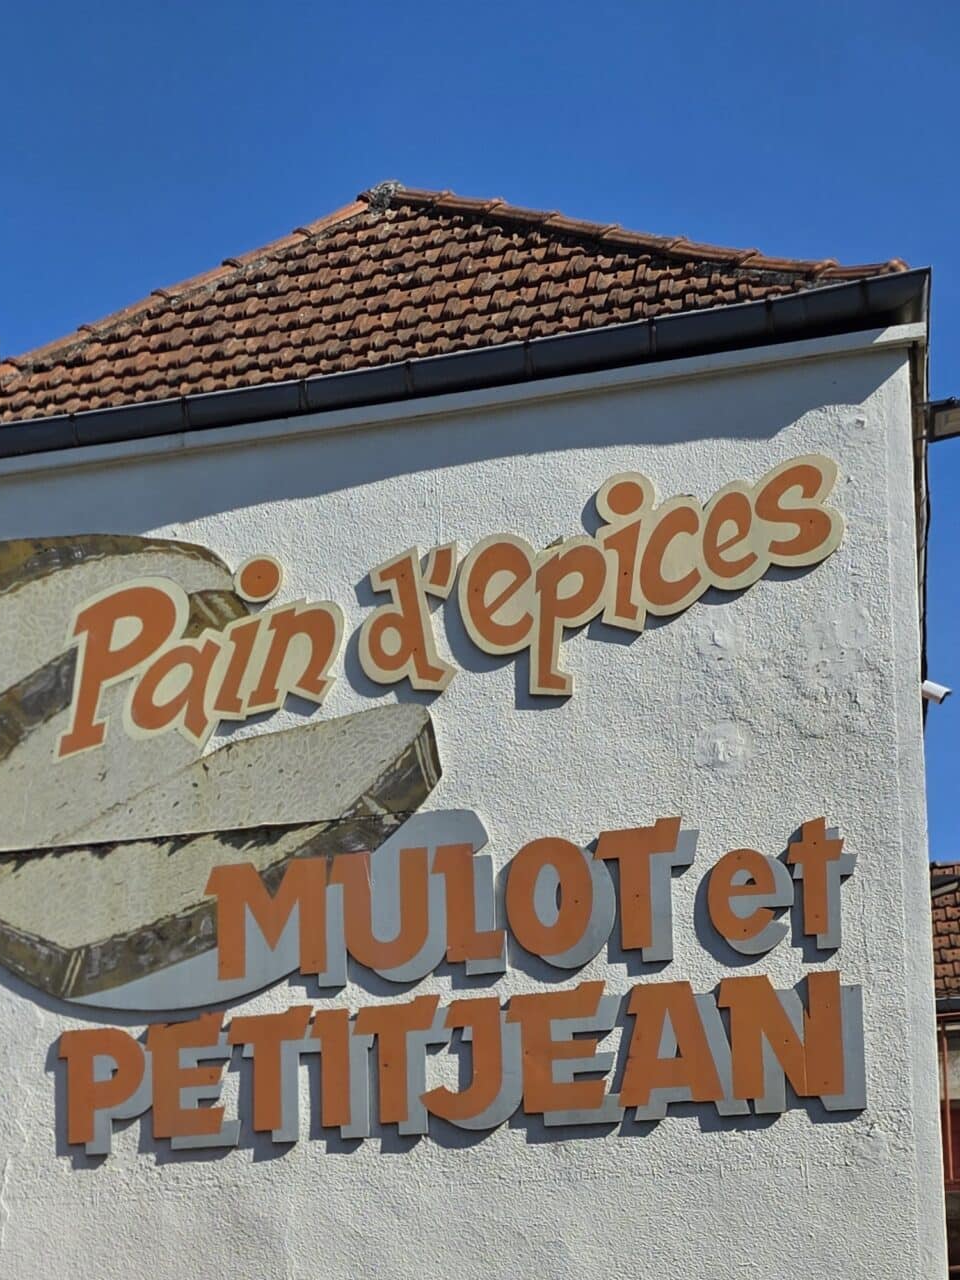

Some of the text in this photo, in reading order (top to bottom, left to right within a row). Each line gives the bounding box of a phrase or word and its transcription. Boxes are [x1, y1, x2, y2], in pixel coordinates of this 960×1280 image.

[58, 556, 338, 757] Pain
[204, 816, 843, 980] MULOT et
[59, 970, 845, 1145] PETITJEAN
